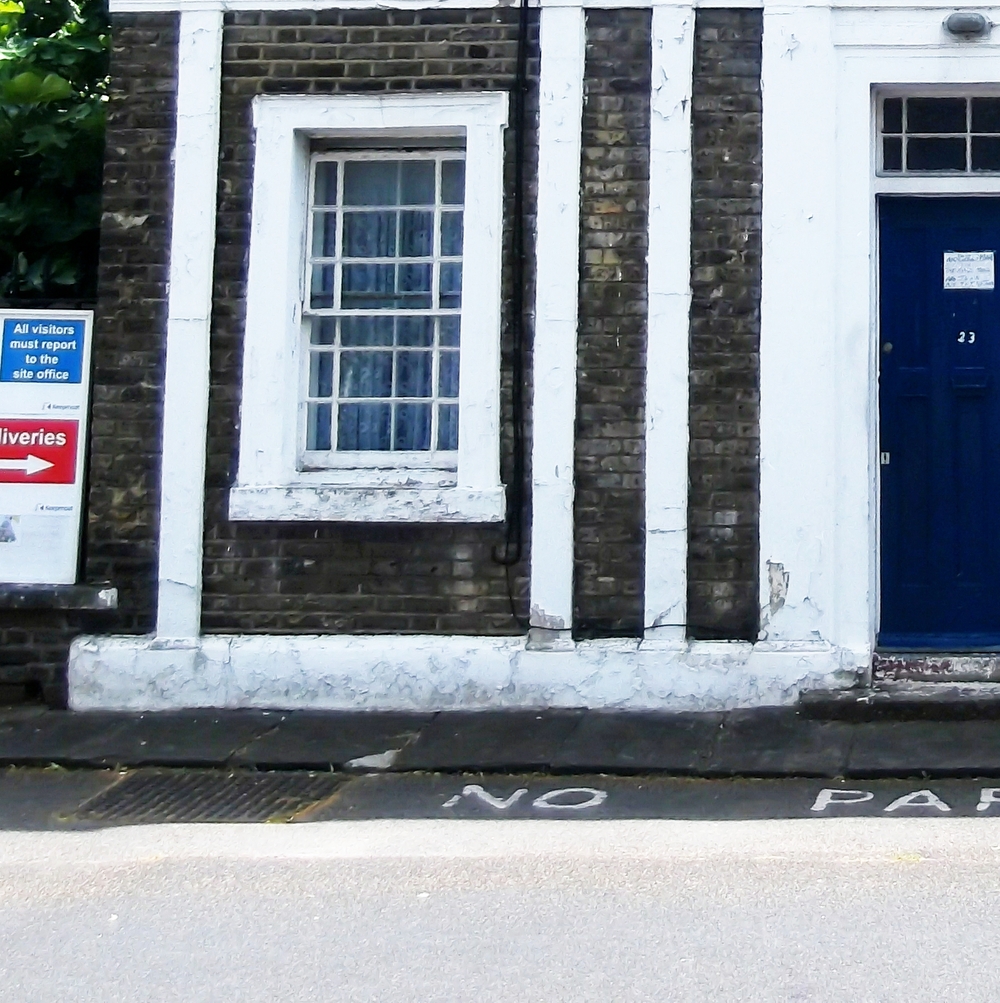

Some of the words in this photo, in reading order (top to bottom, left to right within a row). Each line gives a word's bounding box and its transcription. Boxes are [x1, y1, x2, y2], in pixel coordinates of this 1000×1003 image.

[13, 323, 29, 334] All
[32, 323, 75, 335] visitors
[957, 331, 975, 344] 23
[9, 339, 39, 349] must
[41, 339, 77, 352] report
[25, 354, 37, 364] to
[40, 354, 59, 365] the
[12, 368, 34, 379] site
[36, 368, 70, 380] office
[441, 784, 607, 809] NO
